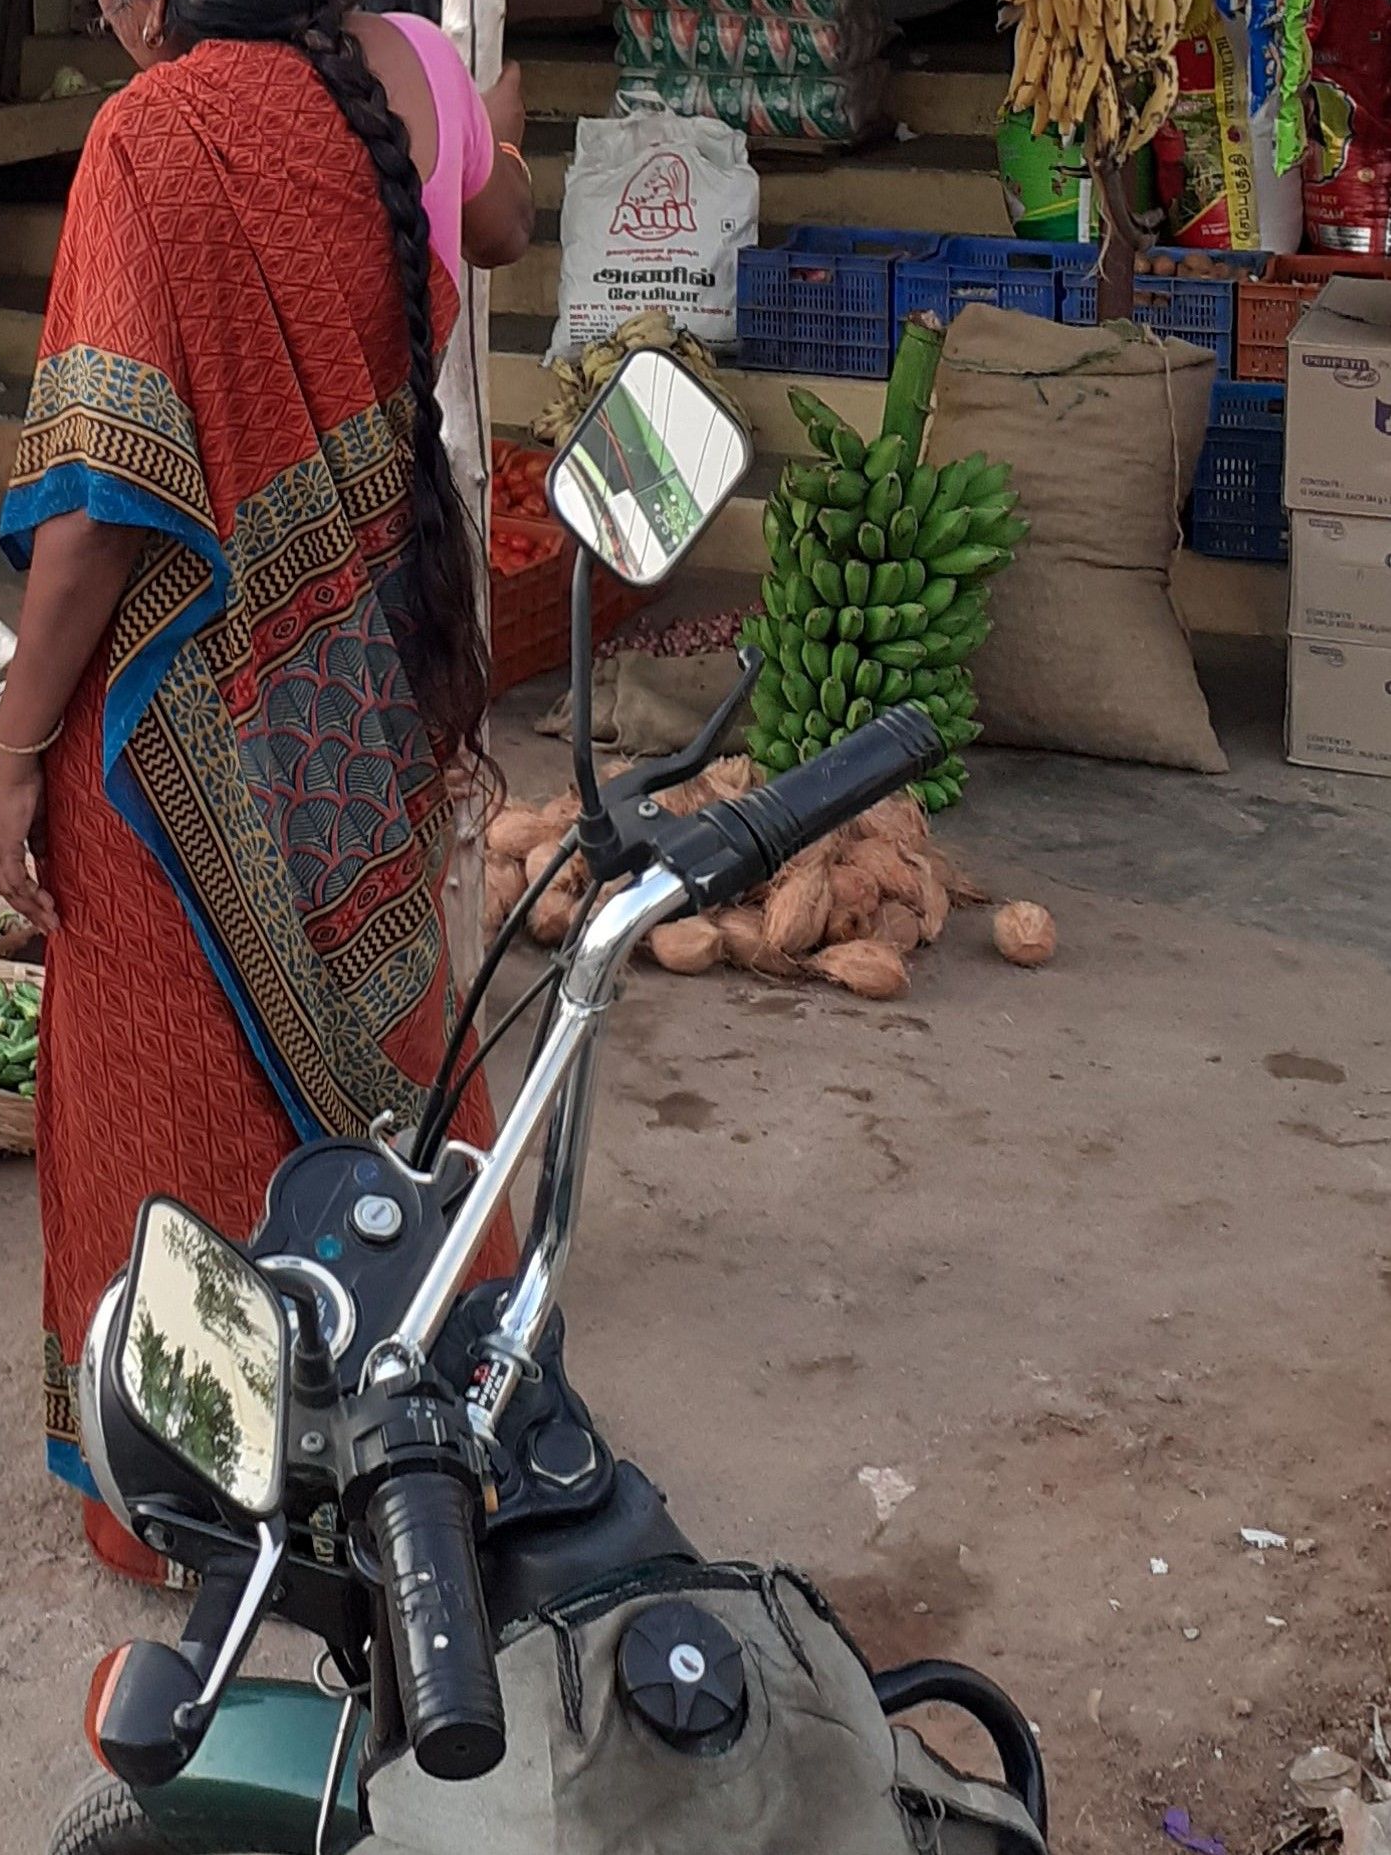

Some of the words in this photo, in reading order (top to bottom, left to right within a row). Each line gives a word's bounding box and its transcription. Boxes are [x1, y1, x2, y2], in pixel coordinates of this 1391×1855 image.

[610, 200, 697, 235] Anil
[593, 266, 716, 288] அணில்
[608, 287, 700, 303] சேமியா
